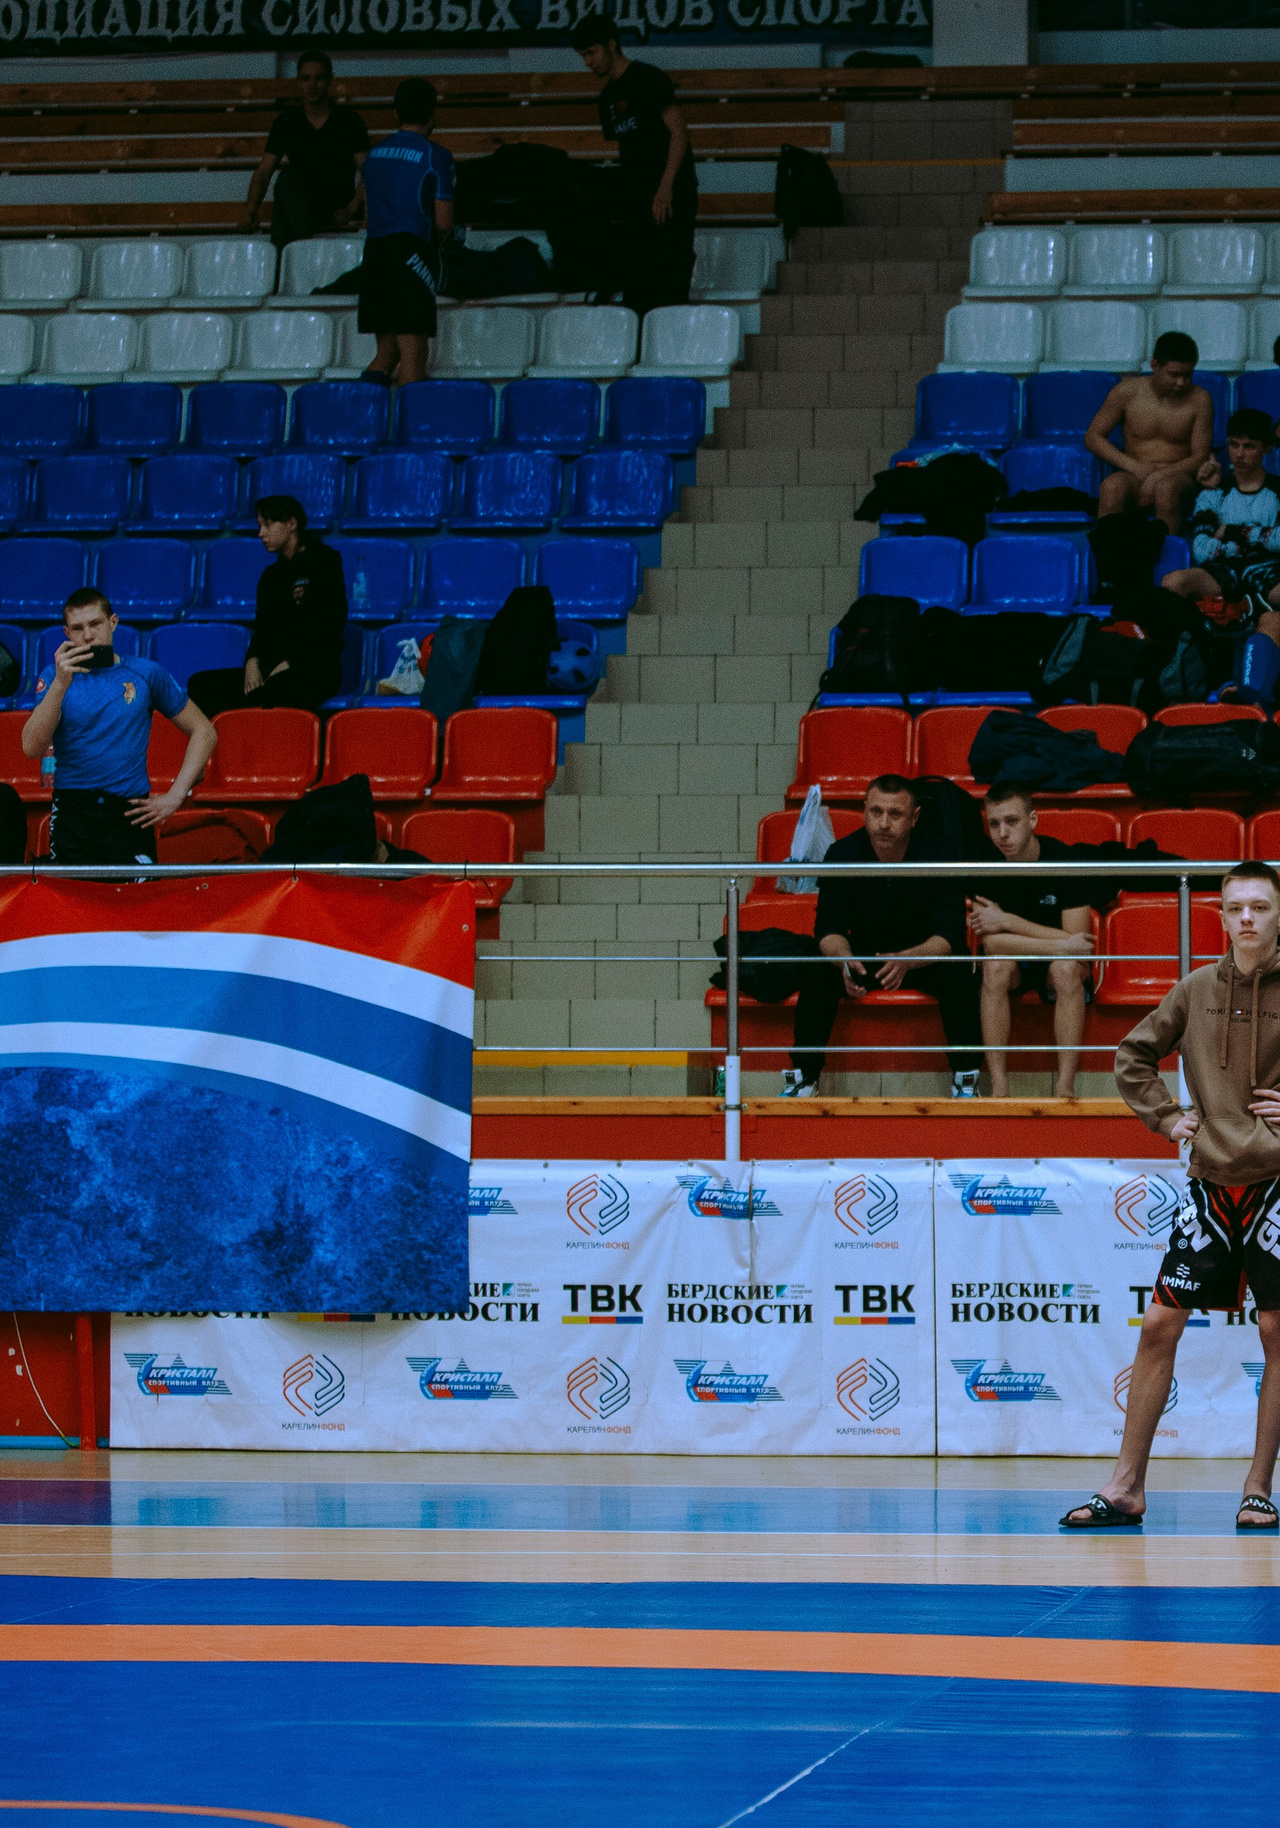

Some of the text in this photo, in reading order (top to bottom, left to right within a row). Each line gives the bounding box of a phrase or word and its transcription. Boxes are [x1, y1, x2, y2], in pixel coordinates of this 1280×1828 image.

[261, 0, 521, 36] СИЛОВЫХ
[536, 0, 714, 37] ВИДОВ
[727, 0, 930, 27] СПОРТА
[974, 1188, 1042, 1198] КРИСТАЛЛ
[1114, 1242, 1167, 1251] КАРЕЛИНФО
[951, 1283, 1059, 1299] БЕРДСКИЕ
[1162, 1275, 1201, 1291] IMMAF
[563, 1285, 643, 1312] ТВК
[668, 1284, 774, 1300] БЕРДСКИЕ
[835, 1285, 915, 1313] ТВК
[667, 1304, 813, 1324] НОВОСТИ
[951, 1303, 1100, 1324] НОВОСТИ
[149, 1368, 215, 1379] КРИСТАЛЛ
[433, 1373, 499, 1383] КРИСТАЛЛ
[698, 1375, 764, 1385] КРИСТАЛЛ
[977, 1374, 1042, 1384] КРИСТАЛЛ
